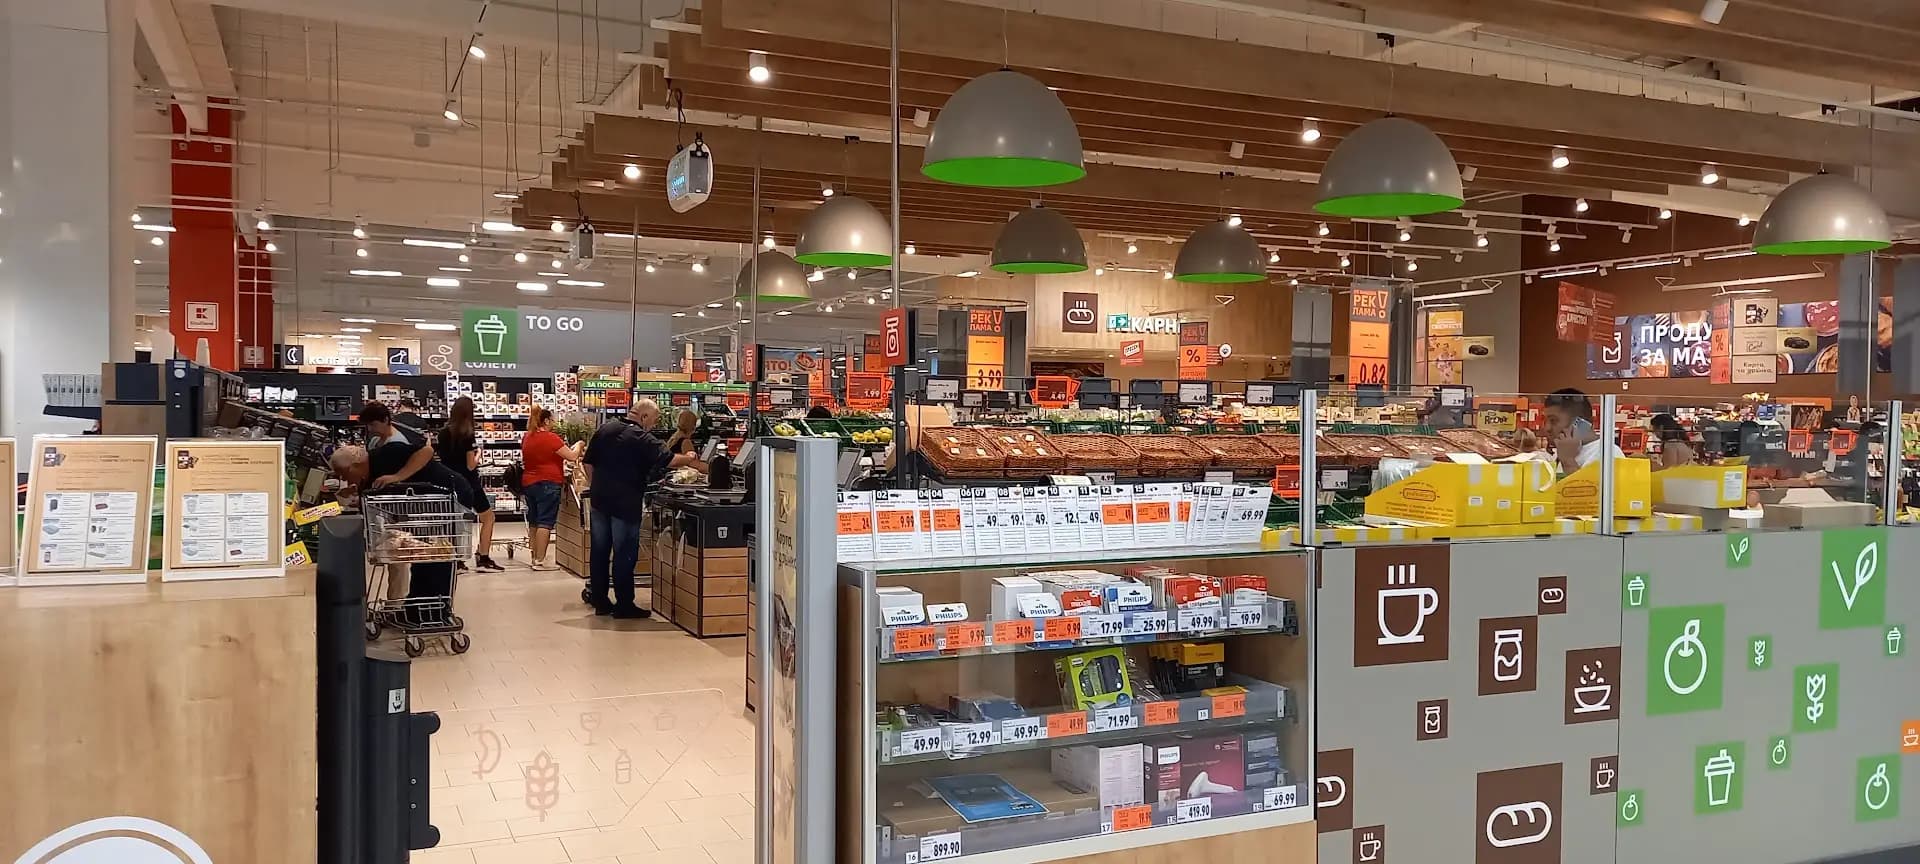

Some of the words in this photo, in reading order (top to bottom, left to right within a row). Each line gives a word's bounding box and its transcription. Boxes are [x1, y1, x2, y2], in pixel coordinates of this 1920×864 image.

[1353, 294, 1376, 306] РЕК
[1352, 306, 1376, 317] ЛАМА
[526, 315, 551, 330] TO
[557, 317, 584, 331] GO
[970, 313, 991, 324] РЕК
[1107, 316, 1180, 333] КАРН
[970, 323, 993, 331] ЛАМА
[1640, 322, 1712, 346] ПРОДУ
[1640, 348, 1666, 367] ЗА
[1672, 346, 1712, 366] МА
[977, 369, 1002, 388] 3.99
[1360, 363, 1385, 384] 0.82
[919, 490, 929, 498] 04
[932, 490, 942, 498] 04
[1049, 487, 1058, 495] 10
[1134, 484, 1143, 492] 15
[1234, 488, 1243, 496] 19
[877, 491, 888, 499] 02
[900, 515, 915, 528] 9.99
[1241, 510, 1264, 521] 69.99
[891, 614, 920, 622] PHILIPS
[1191, 616, 1213, 628] 49.99
[1240, 613, 1261, 625] 19.99
[1067, 622, 1081, 635] 9.99
[1101, 622, 1123, 634] 17.99
[1143, 619, 1166, 632] 25.99
[969, 630, 985, 643] 9.99
[1108, 714, 1130, 728] 71.99
[967, 730, 991, 745] 12.99
[1014, 725, 1039, 738] 49.99
[914, 736, 940, 751] 49.99
[1274, 792, 1295, 806] 69.99
[1188, 805, 1210, 818] 419.90
[1102, 824, 1111, 832] 17
[933, 841, 960, 857] 899.90
